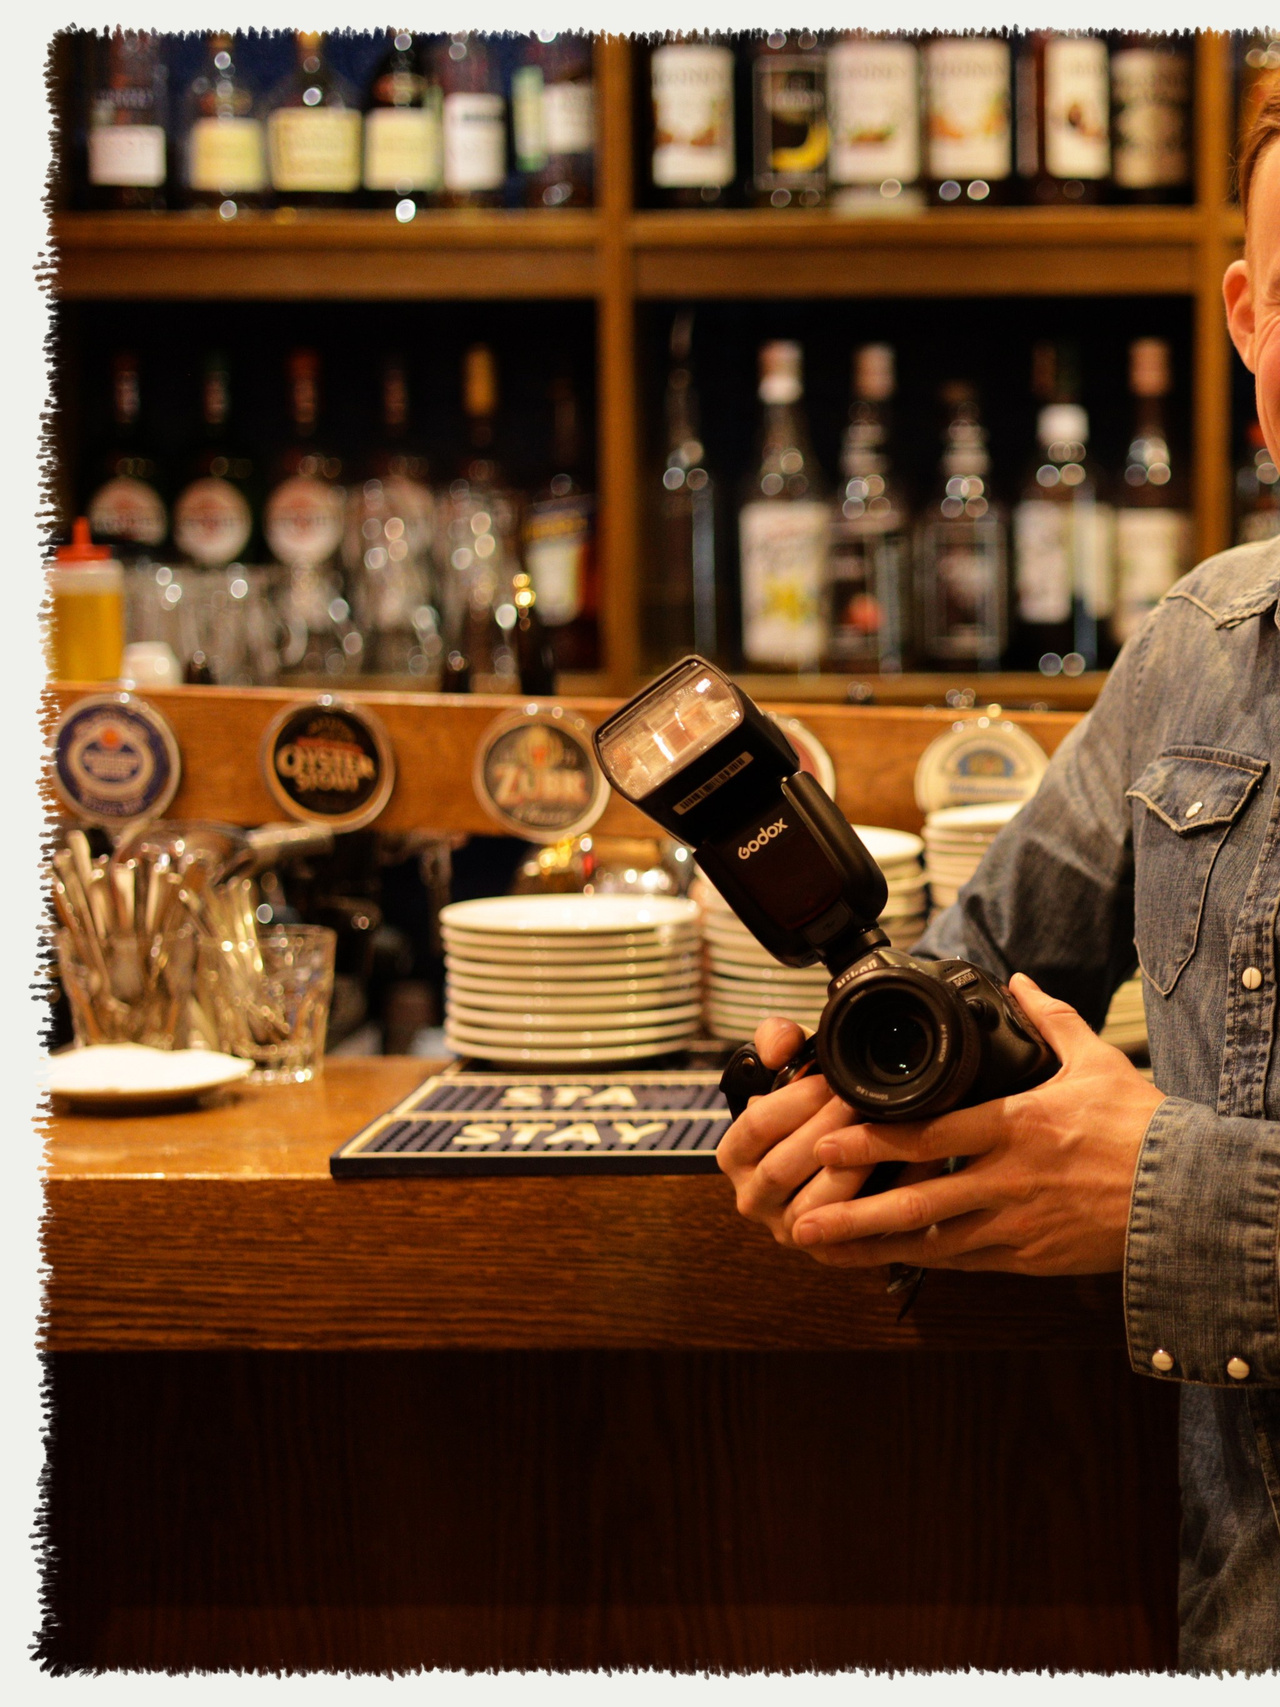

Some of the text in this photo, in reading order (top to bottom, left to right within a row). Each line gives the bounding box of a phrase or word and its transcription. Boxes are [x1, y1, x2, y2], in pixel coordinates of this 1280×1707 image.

[276, 743, 376, 780] OYSTER
[737, 817, 789, 860] Godox
[835, 958, 878, 990] Nikon
[952, 971, 977, 988] D5100
[452, 1122, 669, 1146] STAY
